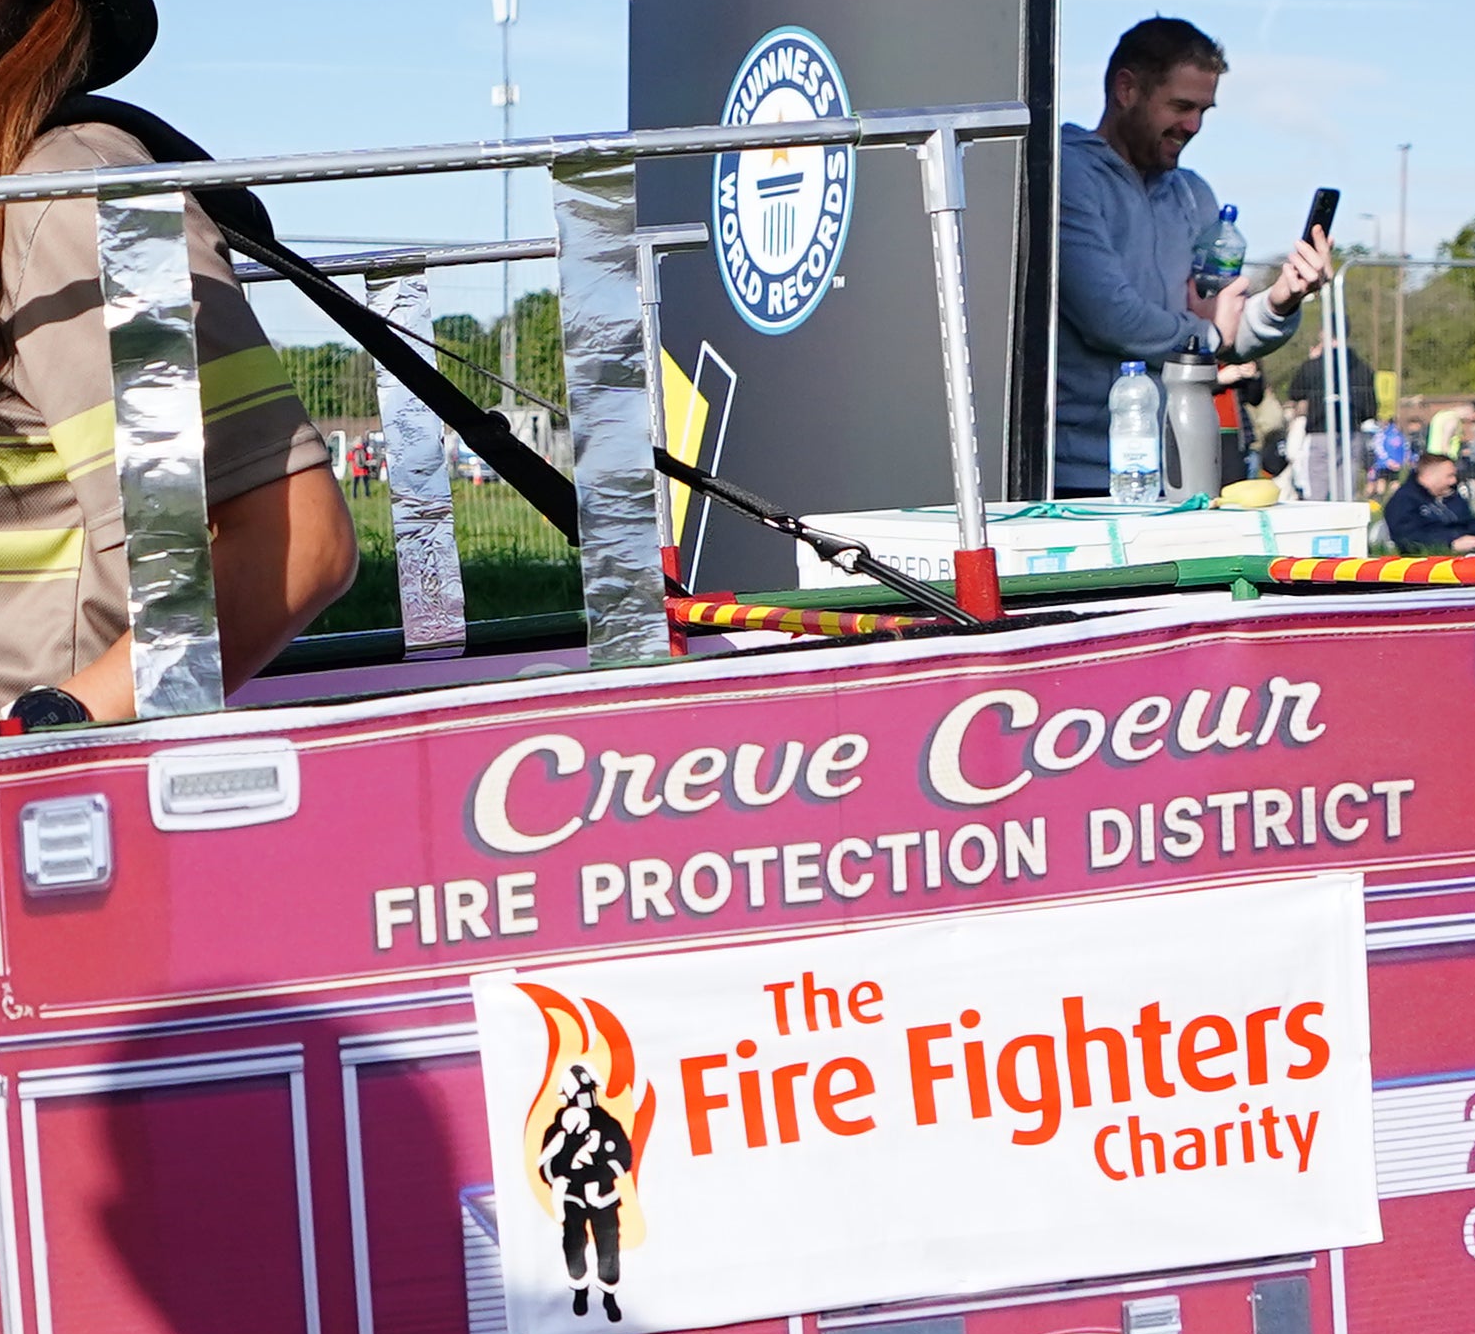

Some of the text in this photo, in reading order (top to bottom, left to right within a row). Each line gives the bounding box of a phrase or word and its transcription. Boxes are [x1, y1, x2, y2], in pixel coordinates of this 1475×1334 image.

[731, 46, 835, 126] GUINNESS
[720, 151, 846, 315] WORLD RECORDS
[468, 675, 1326, 855] Creve Coeur
[374, 778, 1416, 950] FIRE PROTECTION DISTRICT
[679, 995, 1331, 1157] Fire Fighters
[763, 971, 884, 1037] The
[1093, 1103, 1321, 1182] Charity
